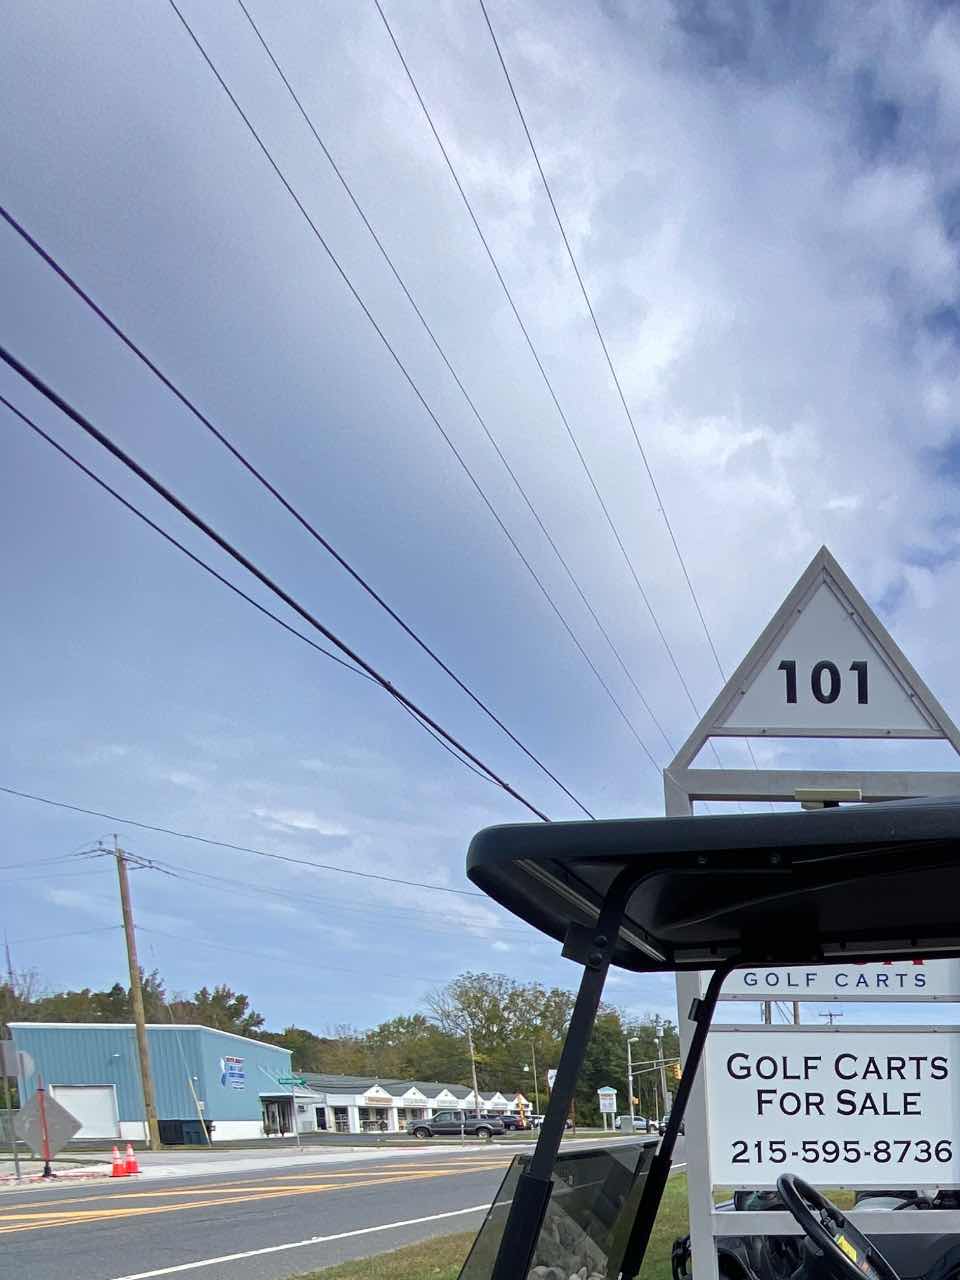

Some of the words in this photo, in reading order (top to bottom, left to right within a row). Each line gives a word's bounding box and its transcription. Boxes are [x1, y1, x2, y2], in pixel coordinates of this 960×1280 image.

[777, 659, 869, 705] 101
[743, 972, 818, 988] GOLF
[834, 972, 927, 988] CARTS
[726, 1052, 822, 1080] GOLF
[834, 1053, 949, 1081] CARTS
[756, 1089, 825, 1116] FOR
[836, 1088, 922, 1116] SALE
[731, 1139, 953, 1164] 215-595-8736
